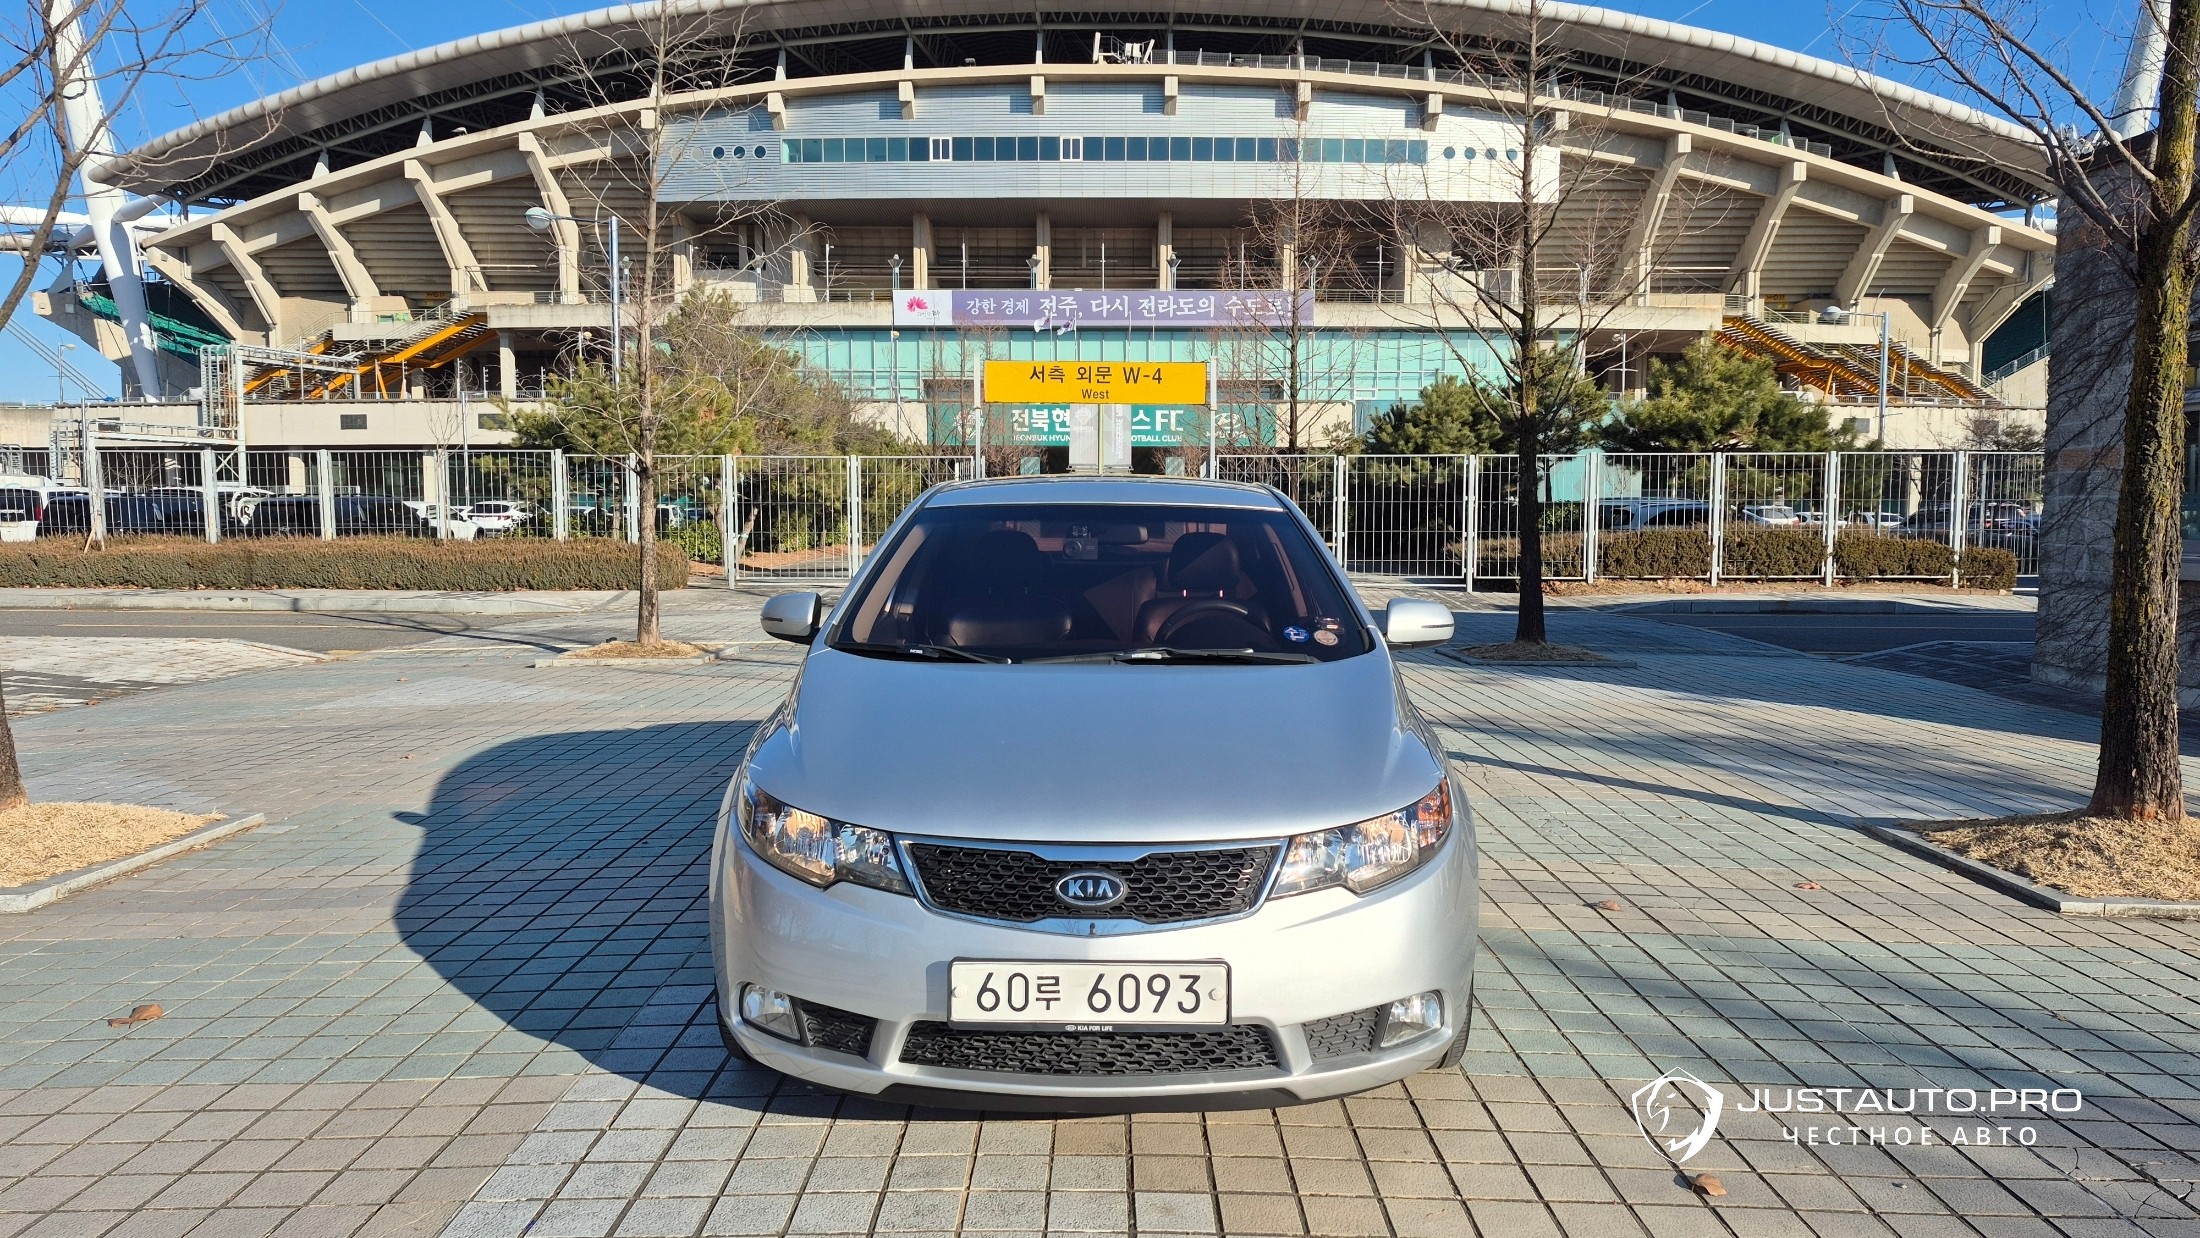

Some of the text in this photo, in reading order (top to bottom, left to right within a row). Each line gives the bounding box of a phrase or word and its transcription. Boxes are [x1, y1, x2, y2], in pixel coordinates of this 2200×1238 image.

[966, 298, 996, 315] 강한
[1001, 298, 1029, 315] 경제
[1040, 296, 1082, 317] 전주,
[1091, 296, 1130, 317] 다시
[1138, 296, 1214, 317] 전라도의
[1030, 365, 1162, 384] 서측 외문 W-4
[1082, 389, 1109, 399] West
[1068, 879, 1114, 898] KIA
[976, 972, 1201, 1014] 60루 6093
